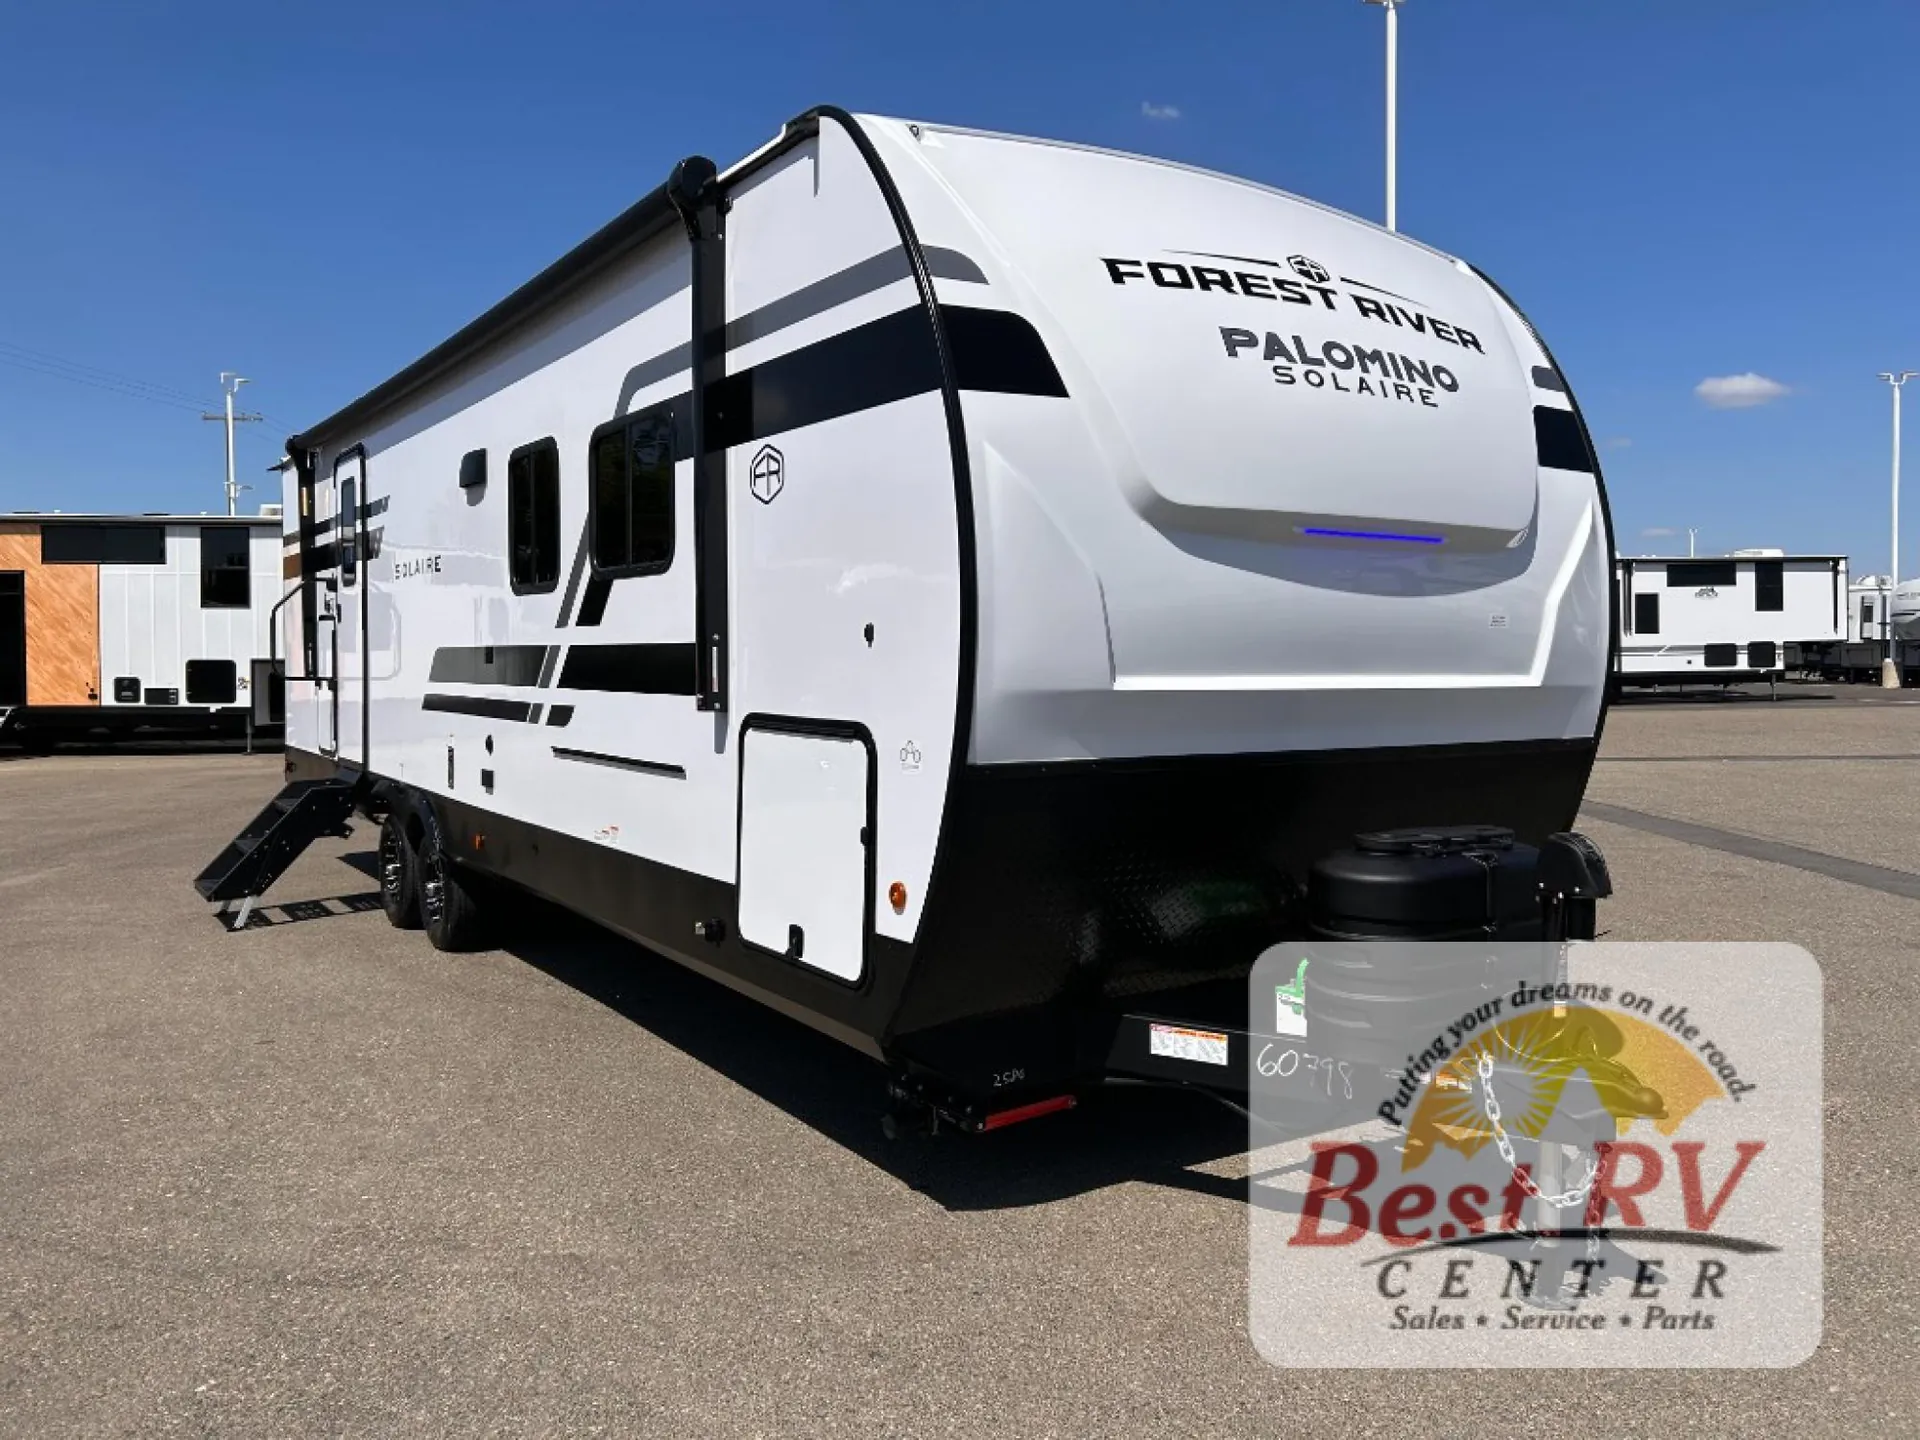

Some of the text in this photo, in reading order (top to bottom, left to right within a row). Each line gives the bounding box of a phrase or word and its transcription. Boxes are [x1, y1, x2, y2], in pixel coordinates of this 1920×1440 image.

[1101, 257, 1486, 355] FOREST RIVER
[1219, 325, 1460, 393] PALOMINO
[1272, 364, 1439, 408] SOLAIRE
[394, 554, 442, 581] SOLAIRE
